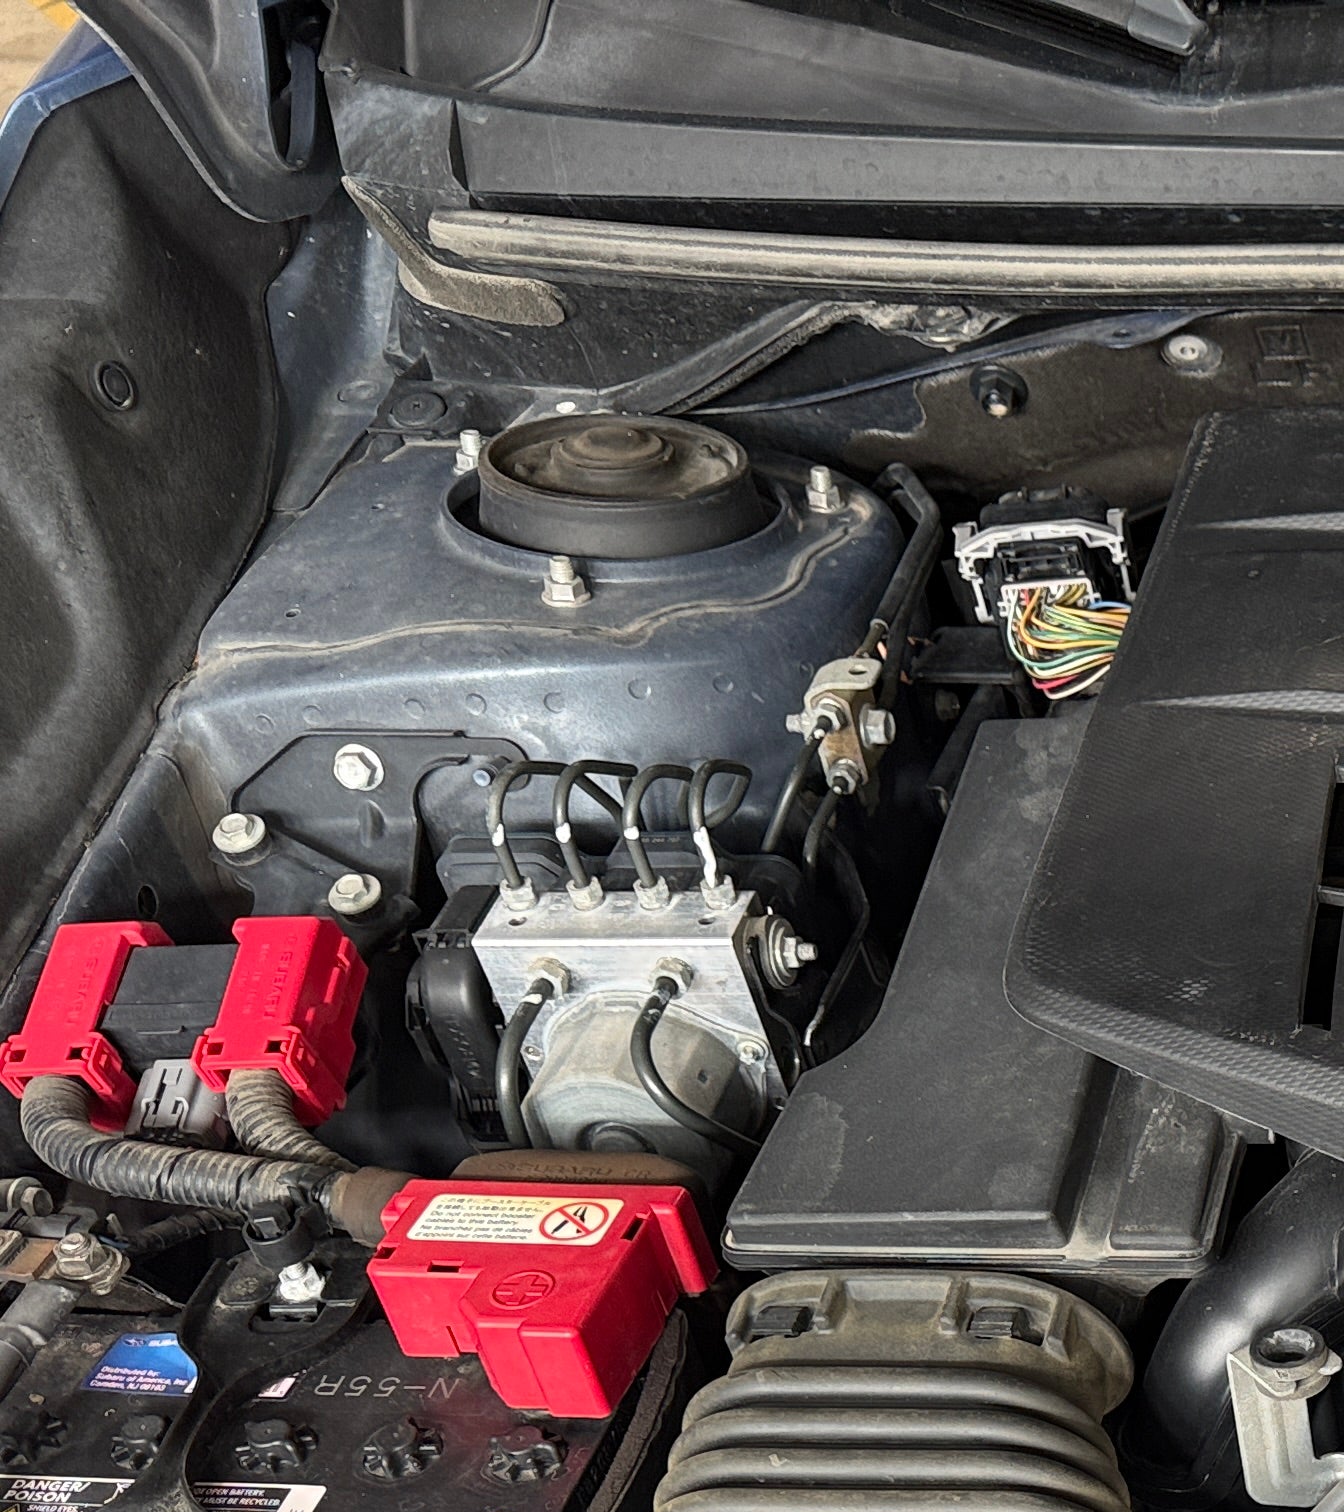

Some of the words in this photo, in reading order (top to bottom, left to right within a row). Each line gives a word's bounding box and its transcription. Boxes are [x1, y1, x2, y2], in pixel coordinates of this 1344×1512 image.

[101, 1366, 147, 1376] Distributed
[95, 1372, 125, 1381] Subaru
[314, 1374, 461, 1398] N-55R
[11, 1479, 91, 1493] DANGER/
[3, 1490, 72, 1503] POISON
[206, 1488, 229, 1496] OPEN
[27, 1504, 57, 1512] SHIELD
